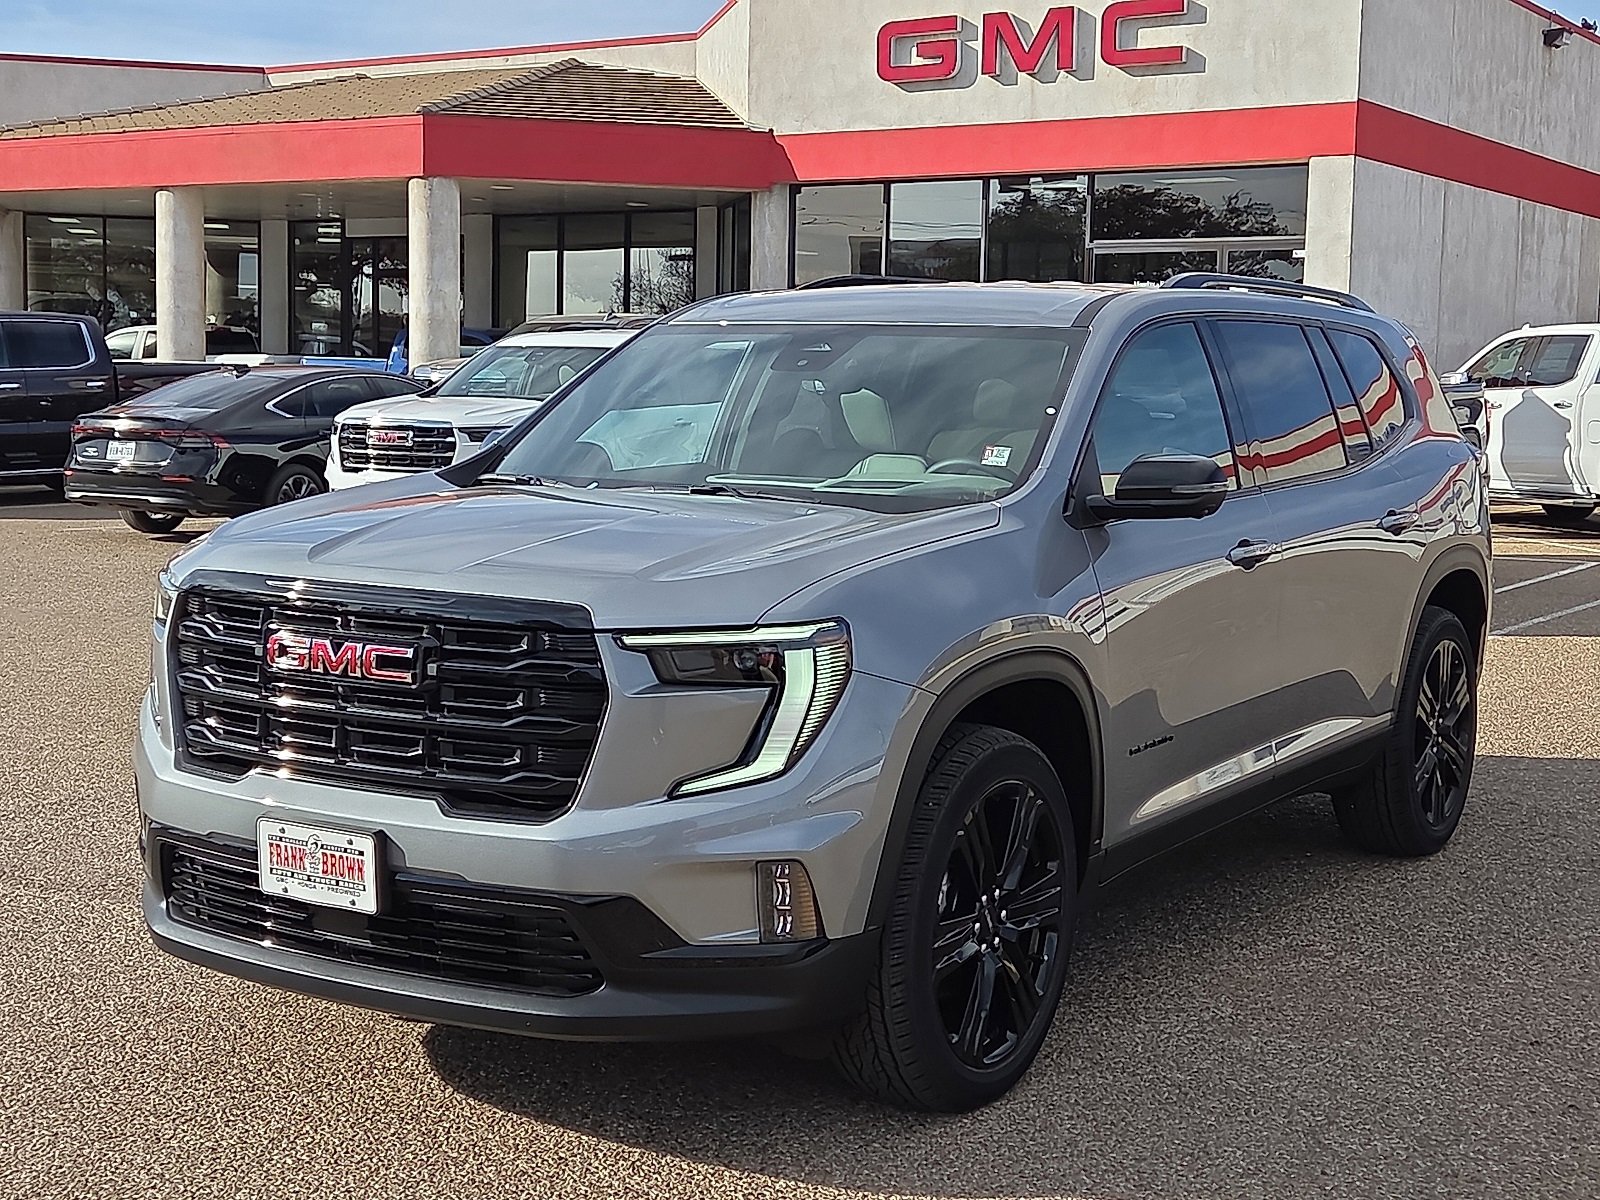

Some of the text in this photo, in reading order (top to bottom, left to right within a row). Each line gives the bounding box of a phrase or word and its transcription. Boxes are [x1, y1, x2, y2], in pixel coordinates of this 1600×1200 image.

[877, 0, 1188, 82] GMC
[267, 631, 414, 683] GMC
[268, 842, 366, 882] FRANK BROWN
[271, 868, 293, 878] AUTO
[293, 872, 309, 881] AND
[310, 875, 338, 886] TRUCK
